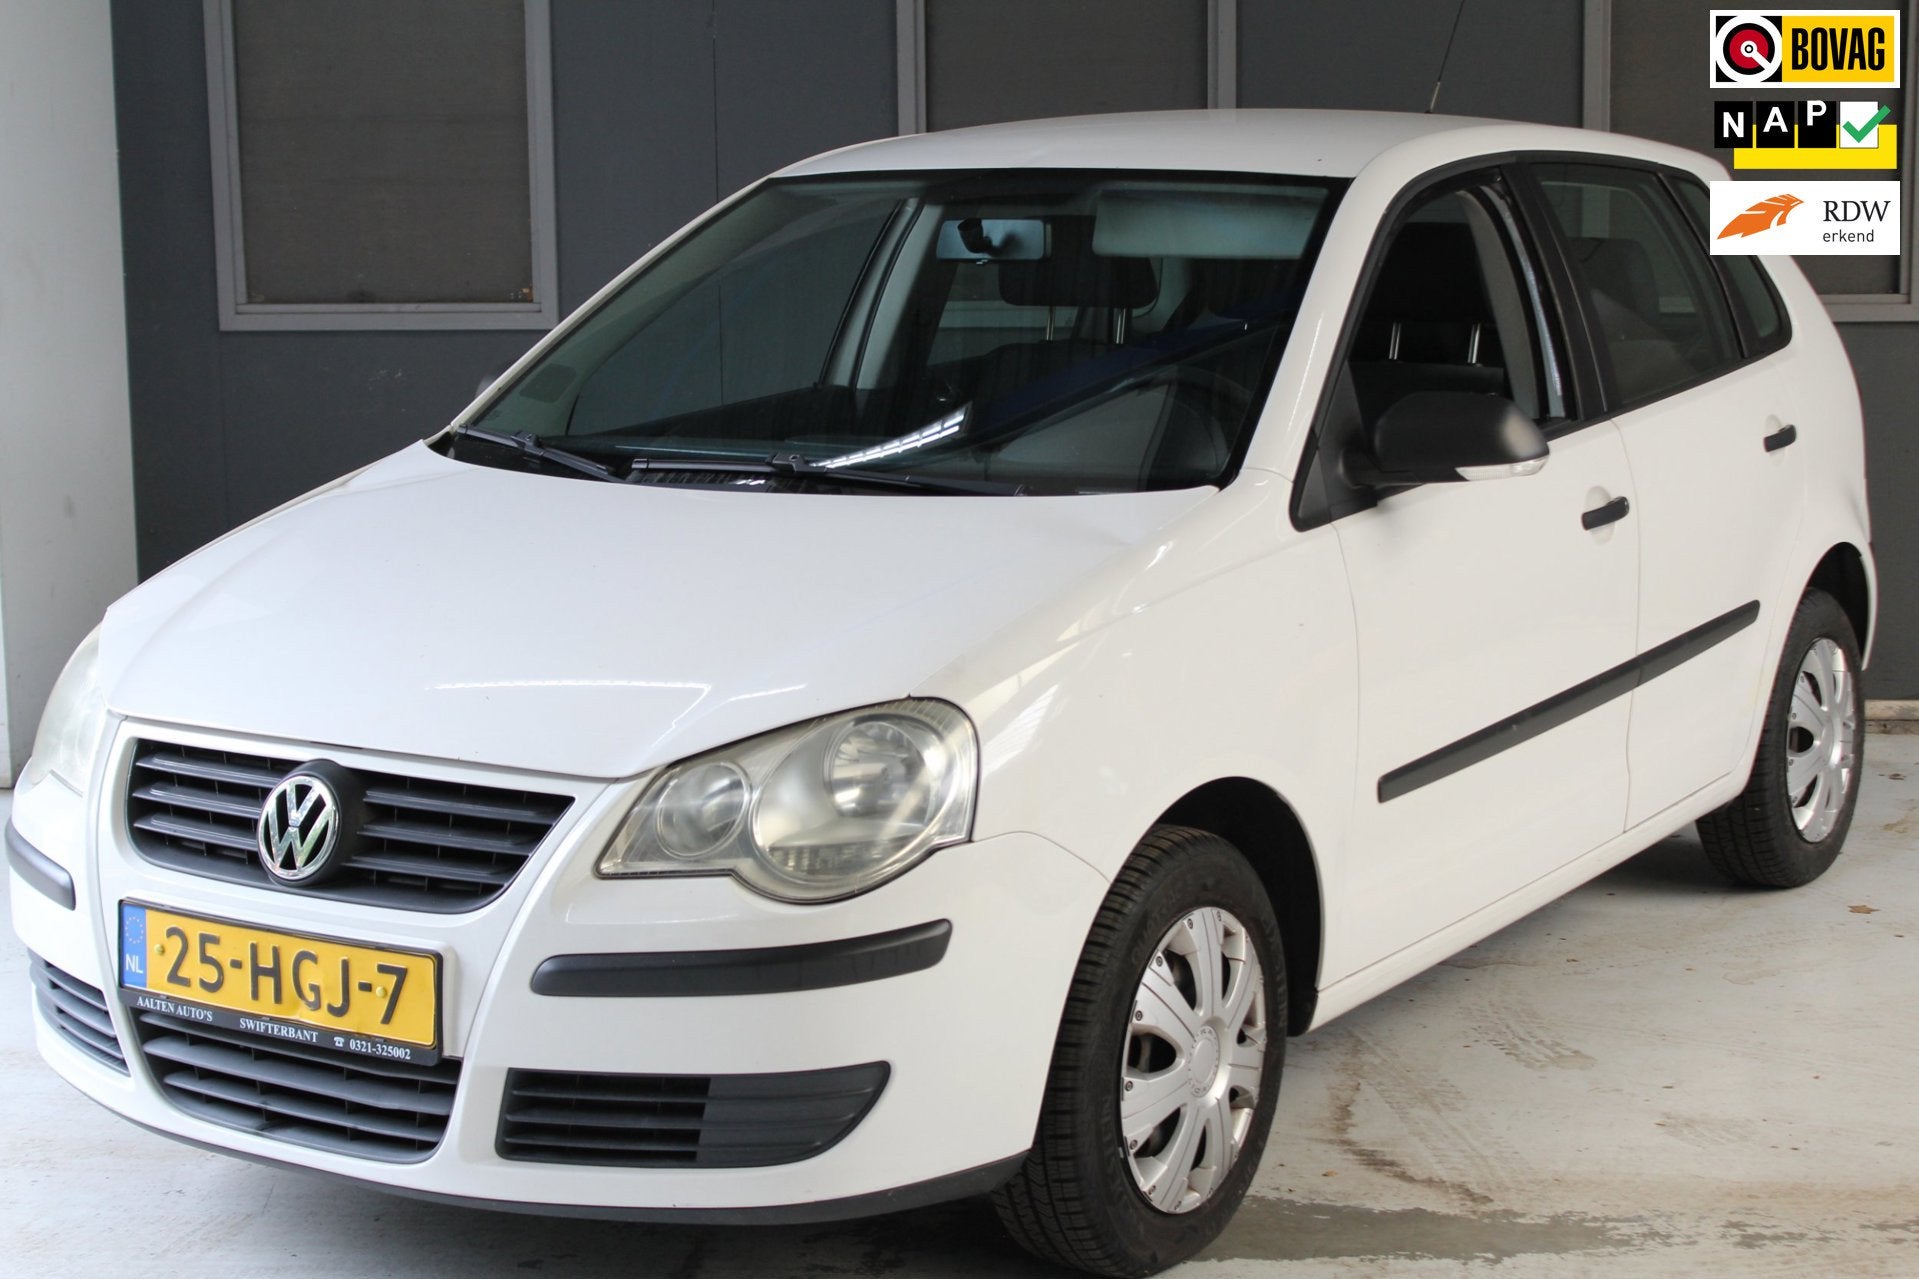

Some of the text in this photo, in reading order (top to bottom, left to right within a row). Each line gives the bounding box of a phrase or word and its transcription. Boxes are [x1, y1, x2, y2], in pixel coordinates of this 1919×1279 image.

[125, 953, 144, 975] NL
[165, 926, 408, 1025] 25-HGJ-7
[137, 995, 412, 1060] AALTEN AUTO'S SWIFTERBANT 0321-325002
